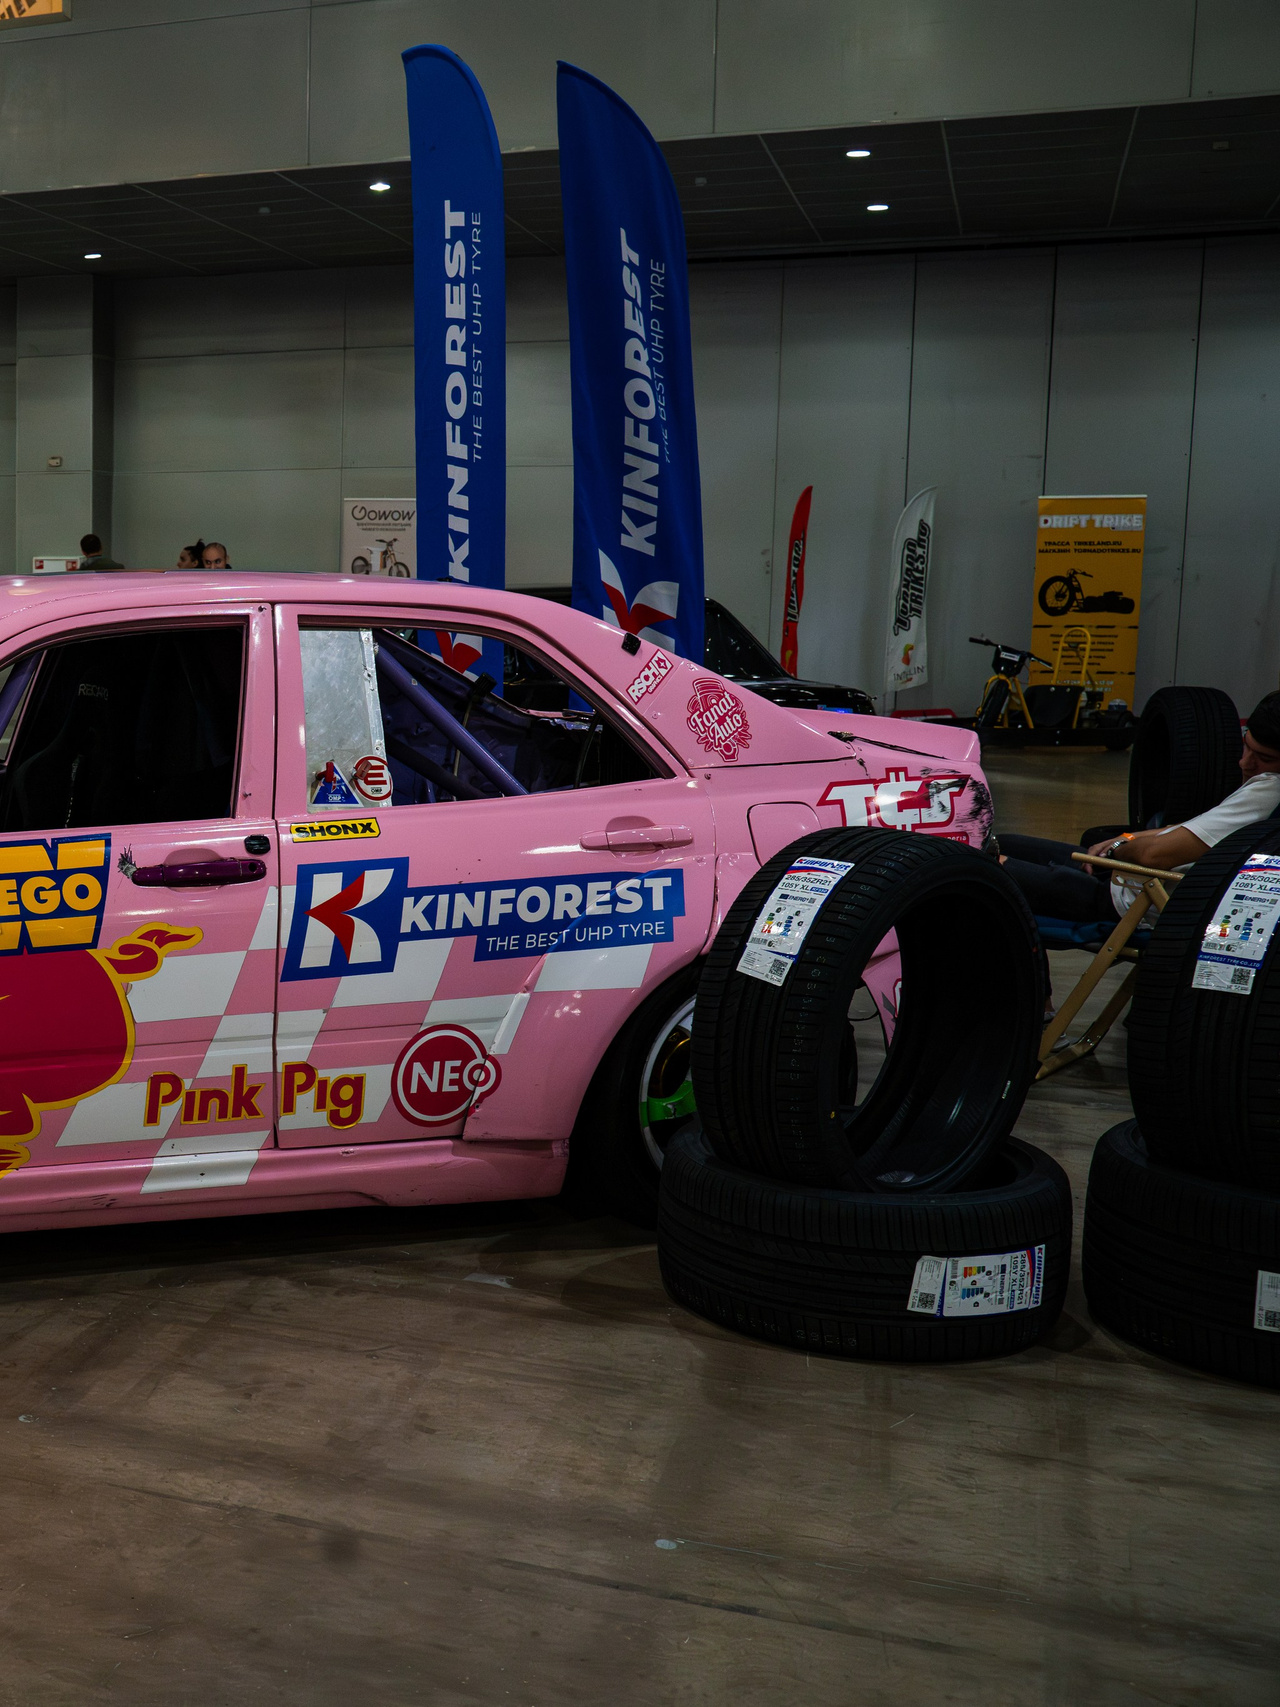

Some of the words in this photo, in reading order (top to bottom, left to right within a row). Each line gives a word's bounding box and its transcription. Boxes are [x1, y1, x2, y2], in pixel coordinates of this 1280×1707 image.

[471, 211, 482, 275] TYRE
[472, 282, 483, 338] UHP
[650, 259, 665, 311] TYRE
[652, 316, 665, 362] UHP
[444, 200, 470, 583] KINFOREST
[472, 347, 483, 412] BEST
[620, 227, 660, 556] KINFOREST
[655, 367, 671, 420] BEST
[472, 421, 483, 463] THE
[690, 690, 736, 734] Fanat
[709, 712, 743, 746] Auto
[294, 821, 375, 838] SHONX
[400, 877, 672, 934] KINFOREST
[785, 874, 832, 887] 285/35ZR21
[1234, 881, 1257, 890] 108Y
[1257, 884, 1270, 892] XL
[486, 935, 519, 952] THE
[525, 930, 570, 948] BEST
[574, 926, 612, 944] UHP
[618, 920, 666, 938] TYRE
[144, 1063, 266, 1127] Pink
[281, 1061, 367, 1130] Pig
[1010, 1279, 1017, 1290] XL
[1017, 1253, 1026, 1305] 285/35ZR21
